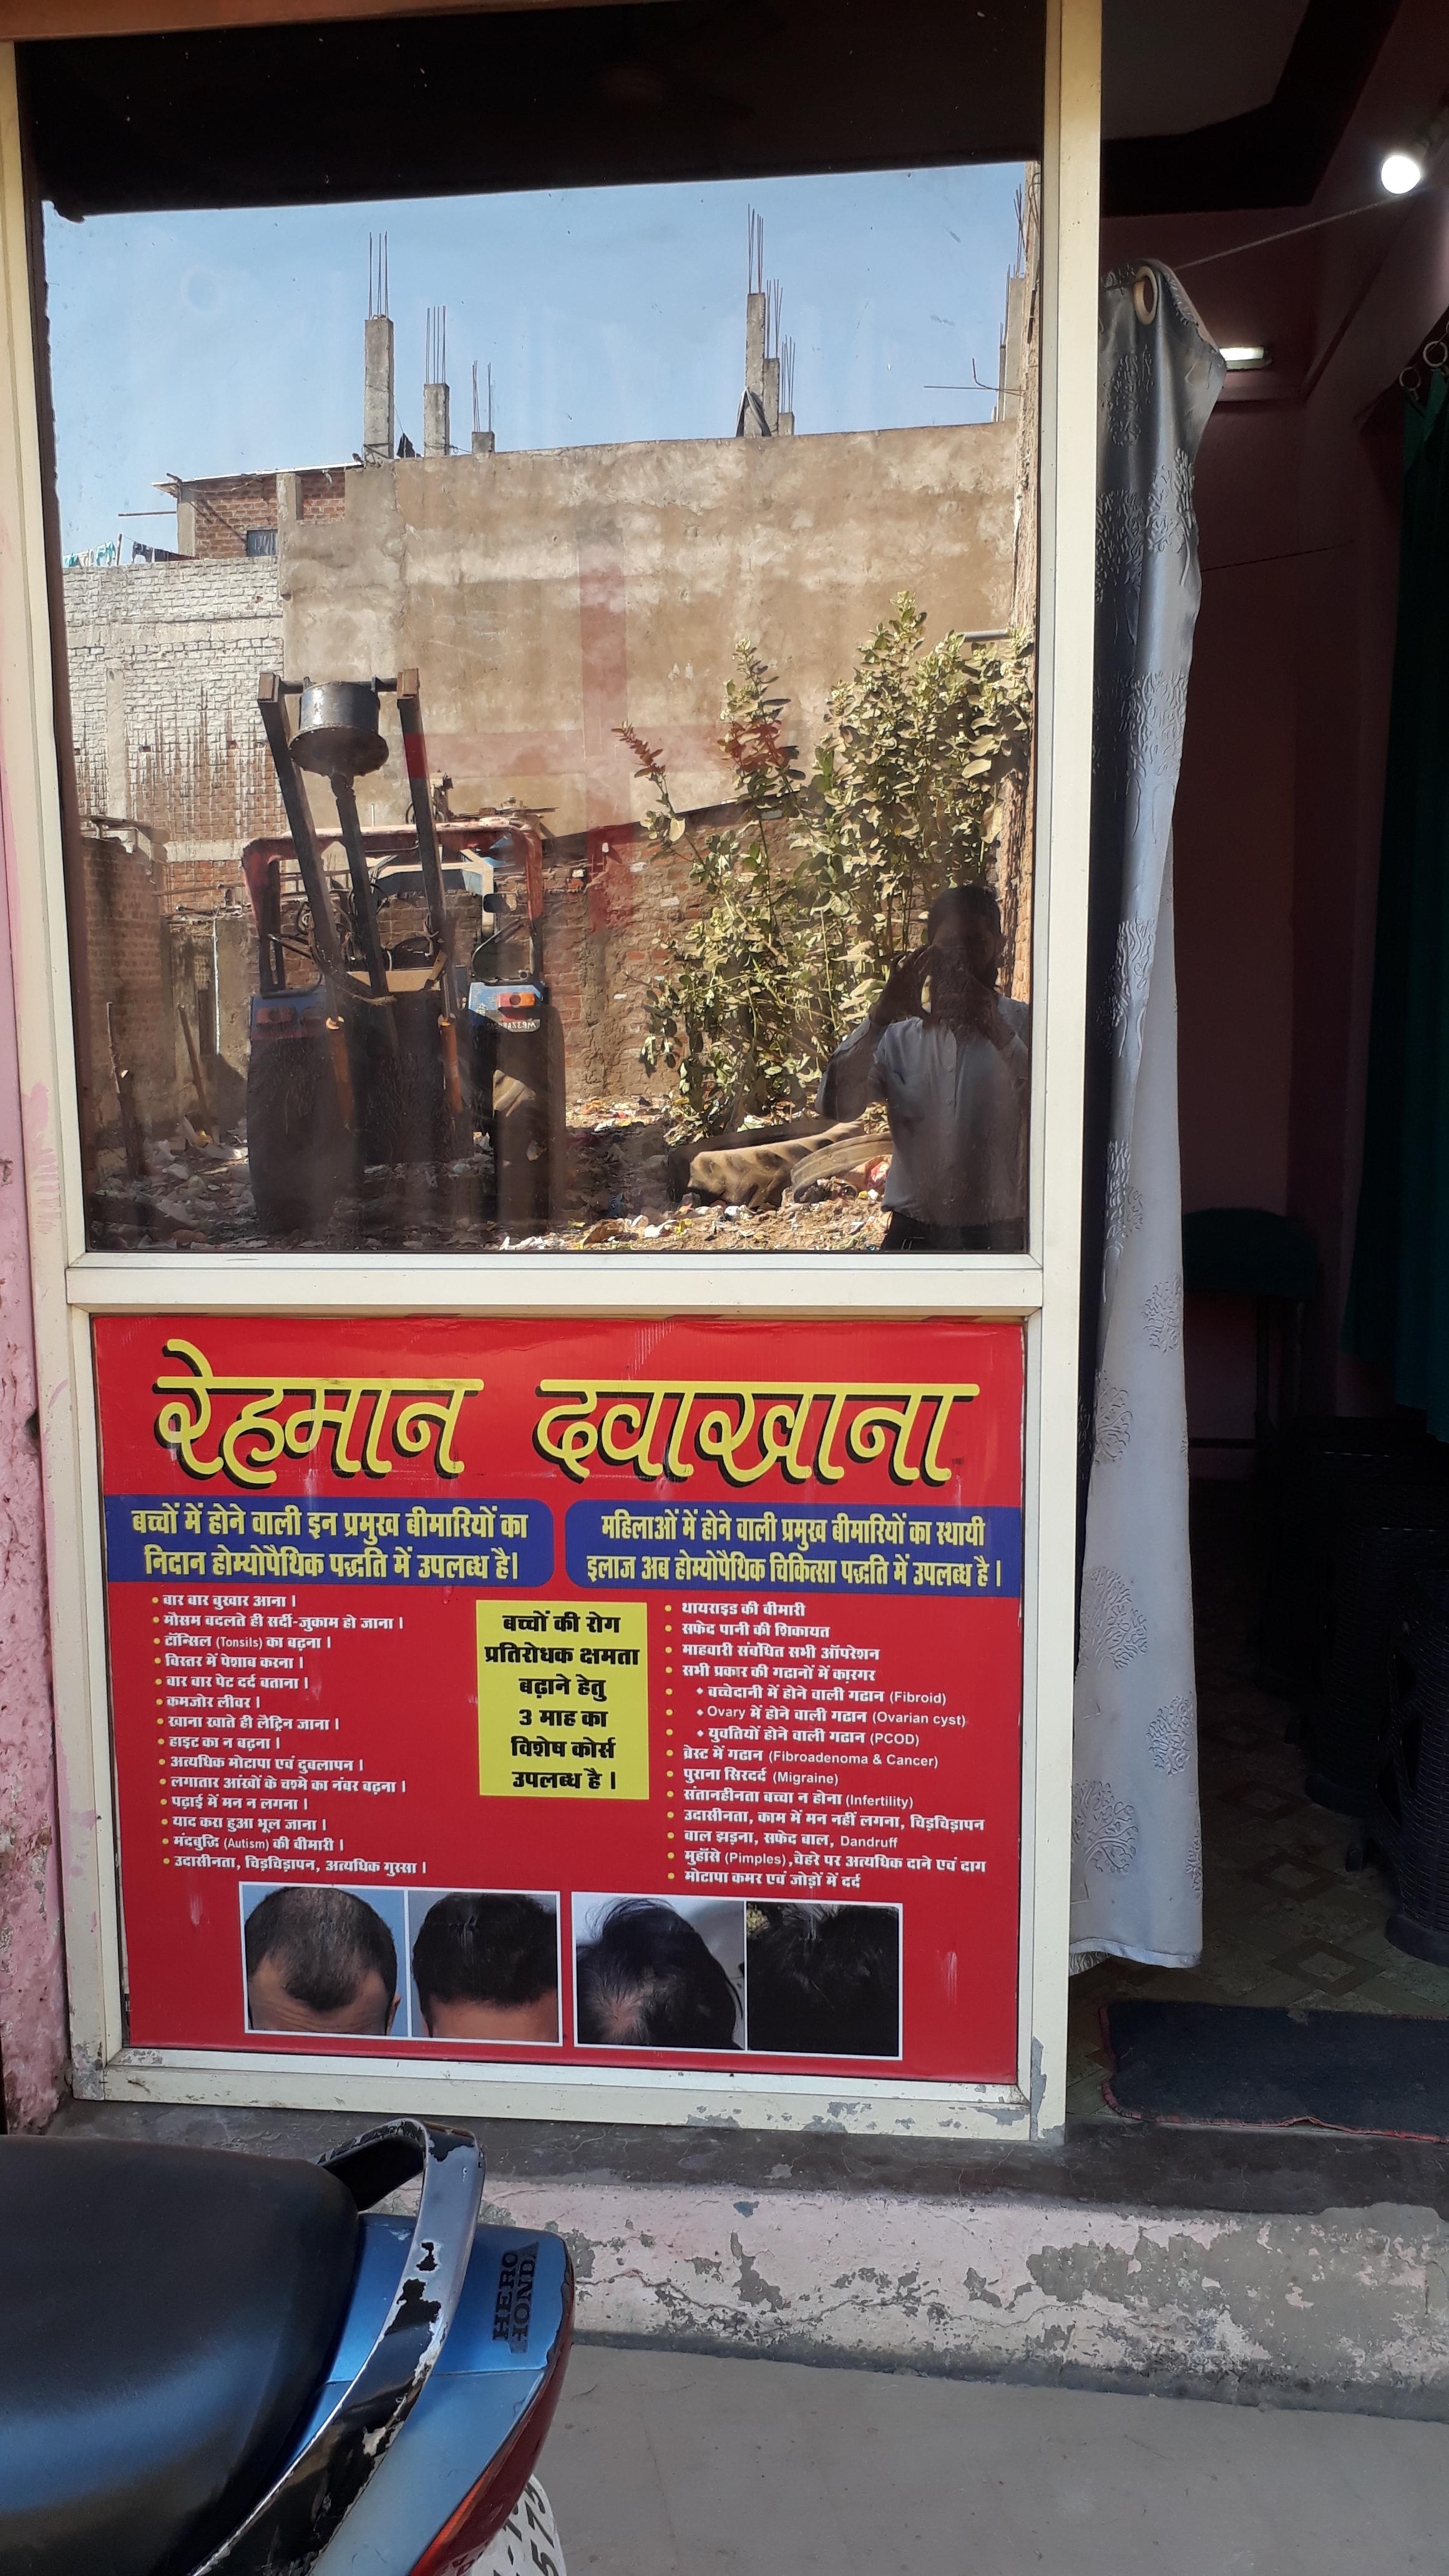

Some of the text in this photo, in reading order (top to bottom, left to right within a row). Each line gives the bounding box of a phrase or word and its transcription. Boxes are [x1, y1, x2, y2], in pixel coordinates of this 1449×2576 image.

[154, 1339, 980, 1488] रेहमान दवाखाना
[132, 1502, 528, 1546] बच्चों में होने वाली इन प्रमुख बीमारियों का
[602, 1509, 985, 1551] महिलाओं में होने वाली प्रमुख बीमारियों का स्थायी
[144, 1544, 206, 1575] निदान
[212, 1544, 324, 1576] होम्योपैथिक
[329, 1547, 388, 1578] पद्धति
[393, 1547, 413, 1578] में
[417, 1555, 489, 1579] उपलब्ध
[587, 1549, 990, 1587] इलाज अब होम्योपैथिक चिकित्सा पद्धति में उपलब्ध है
[162, 1594, 287, 1611] बार बार बुखार आना
[681, 1601, 806, 1617] थायराइड की बीमारी
[163, 1611, 394, 1632] मौसम बदलते ही सर्दी-जुकाम हो जाना
[502, 1610, 622, 1633] बच्चों की रोग
[681, 1619, 831, 1638] सफेद पानी की शिकायत
[164, 1632, 322, 1651] टॉन्सिल (Tonsils) का बढ़ना
[681, 1642, 734, 1657] माहवारी
[788, 1644, 817, 1659] सभी
[821, 1644, 881, 1661] ऑपरेशन
[165, 1652, 295, 1669] बिस्तर में पेशाब करना
[484, 1641, 640, 1666] प्रतिरोधक क्षमता
[166, 1673, 300, 1689] बार बार पेट दर्द बताना
[518, 1673, 607, 1702] बढ़ाने हेतु
[166, 1693, 251, 1709] कमजोर लीवर
[168, 1716, 203, 1728] खाना
[206, 1714, 237, 1728] खाते
[239, 1714, 254, 1729] ही
[296, 1719, 330, 1730] जाना
[519, 1709, 609, 1727] 3 माह का
[707, 1705, 746, 1720] Ovary
[749, 1704, 763, 1720] में
[764, 1705, 791, 1720] होने
[794, 1707, 828, 1722] वाली
[872, 1711, 929, 1724] (Ovarian
[933, 1714, 966, 1728] cyst)
[168, 1736, 271, 1752] हाइट का न बढ़ना
[510, 1735, 617, 1759] विशेष कोर्स
[170, 1754, 354, 1774] अत्यधिक मोटापा एवं दुबलापन
[683, 1744, 710, 1760] ब्रेस्ट
[712, 1745, 725, 1760] में
[769, 1750, 868, 1764] (Fibroadenoma
[872, 1754, 882, 1765] &
[886, 1754, 938, 1769] Cancer)
[511, 1767, 603, 1789] उपलब्ध है
[683, 1766, 839, 1787] पुराना सिरदर्द (Migraine)
[683, 1785, 914, 1810] संतानहीनता बच्चा न होना (Infertility)
[172, 1816, 317, 1833] याद करा हुआ भूल जाना
[683, 1807, 985, 1833] उदासीनता, काम में मन नहीं लगना, चिड़चिड़ापन
[223, 1838, 269, 1852] (Autism)
[272, 1835, 290, 1850] की
[293, 1836, 334, 1852] बीमारी
[684, 1829, 898, 1848] बाल झड़ना, सफेद बाल, Dandruff
[174, 1853, 417, 1877] उदासीनता, चिड़चिड़ापन, अत्यधिक गुस्सा
[684, 1867, 861, 1889] मोटापा कमर एवं जोड़ों में दर्द
[492, 2253, 517, 2341] HERO
